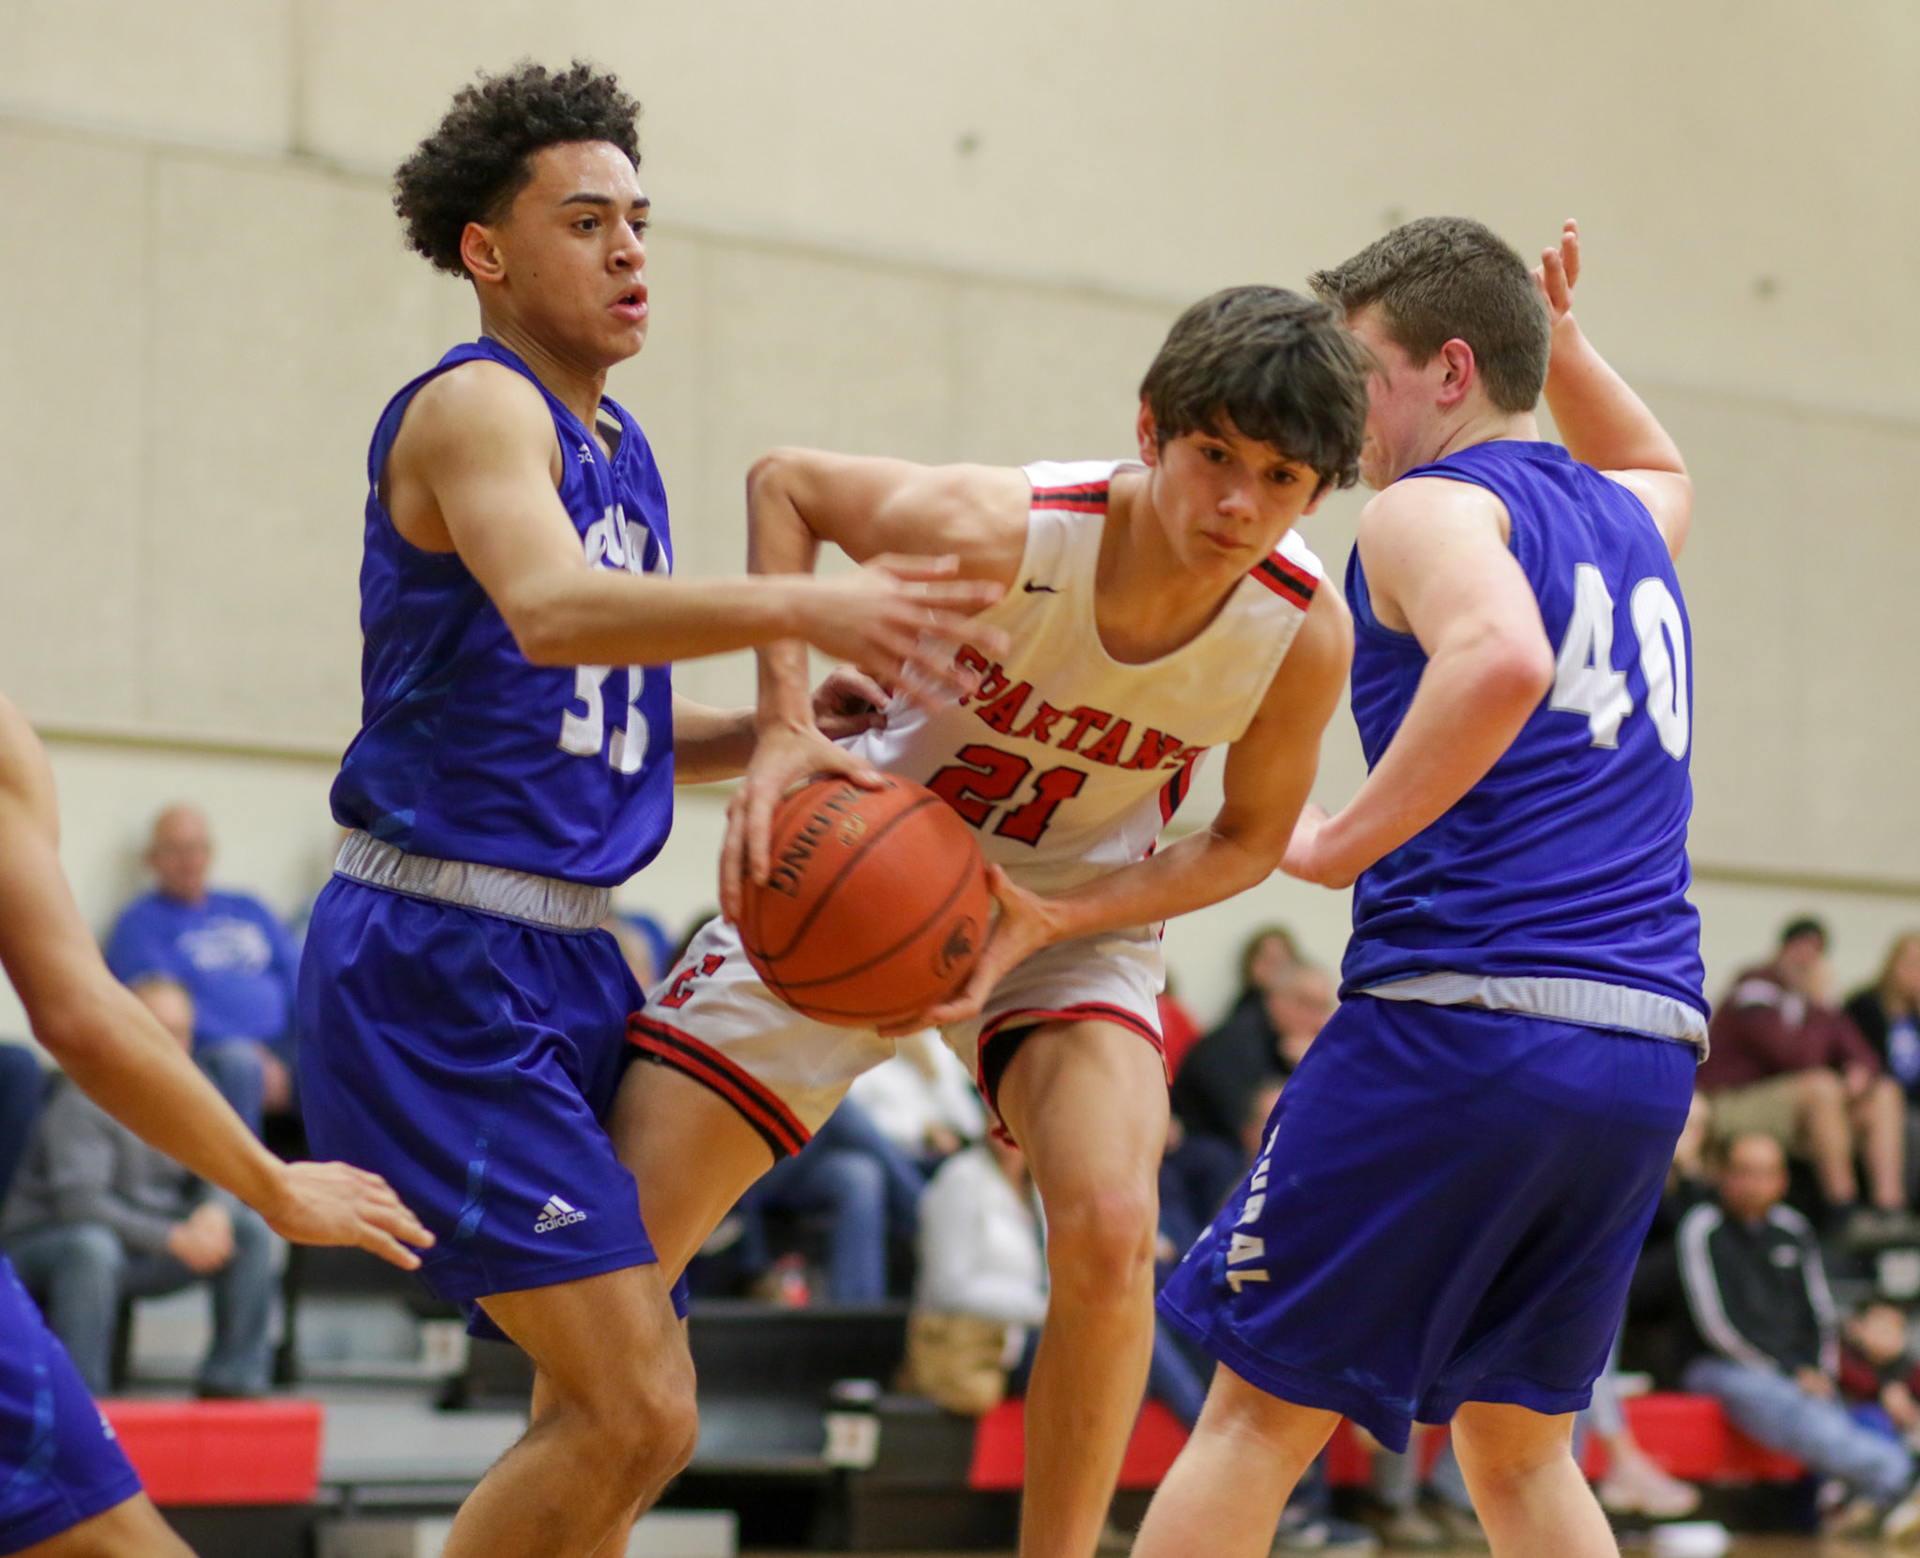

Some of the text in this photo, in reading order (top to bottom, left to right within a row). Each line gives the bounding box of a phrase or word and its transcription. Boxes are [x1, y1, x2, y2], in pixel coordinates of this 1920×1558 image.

[1548, 562, 1689, 762] 40
[925, 744, 1089, 848] 21
[533, 1210, 587, 1234] adidas
